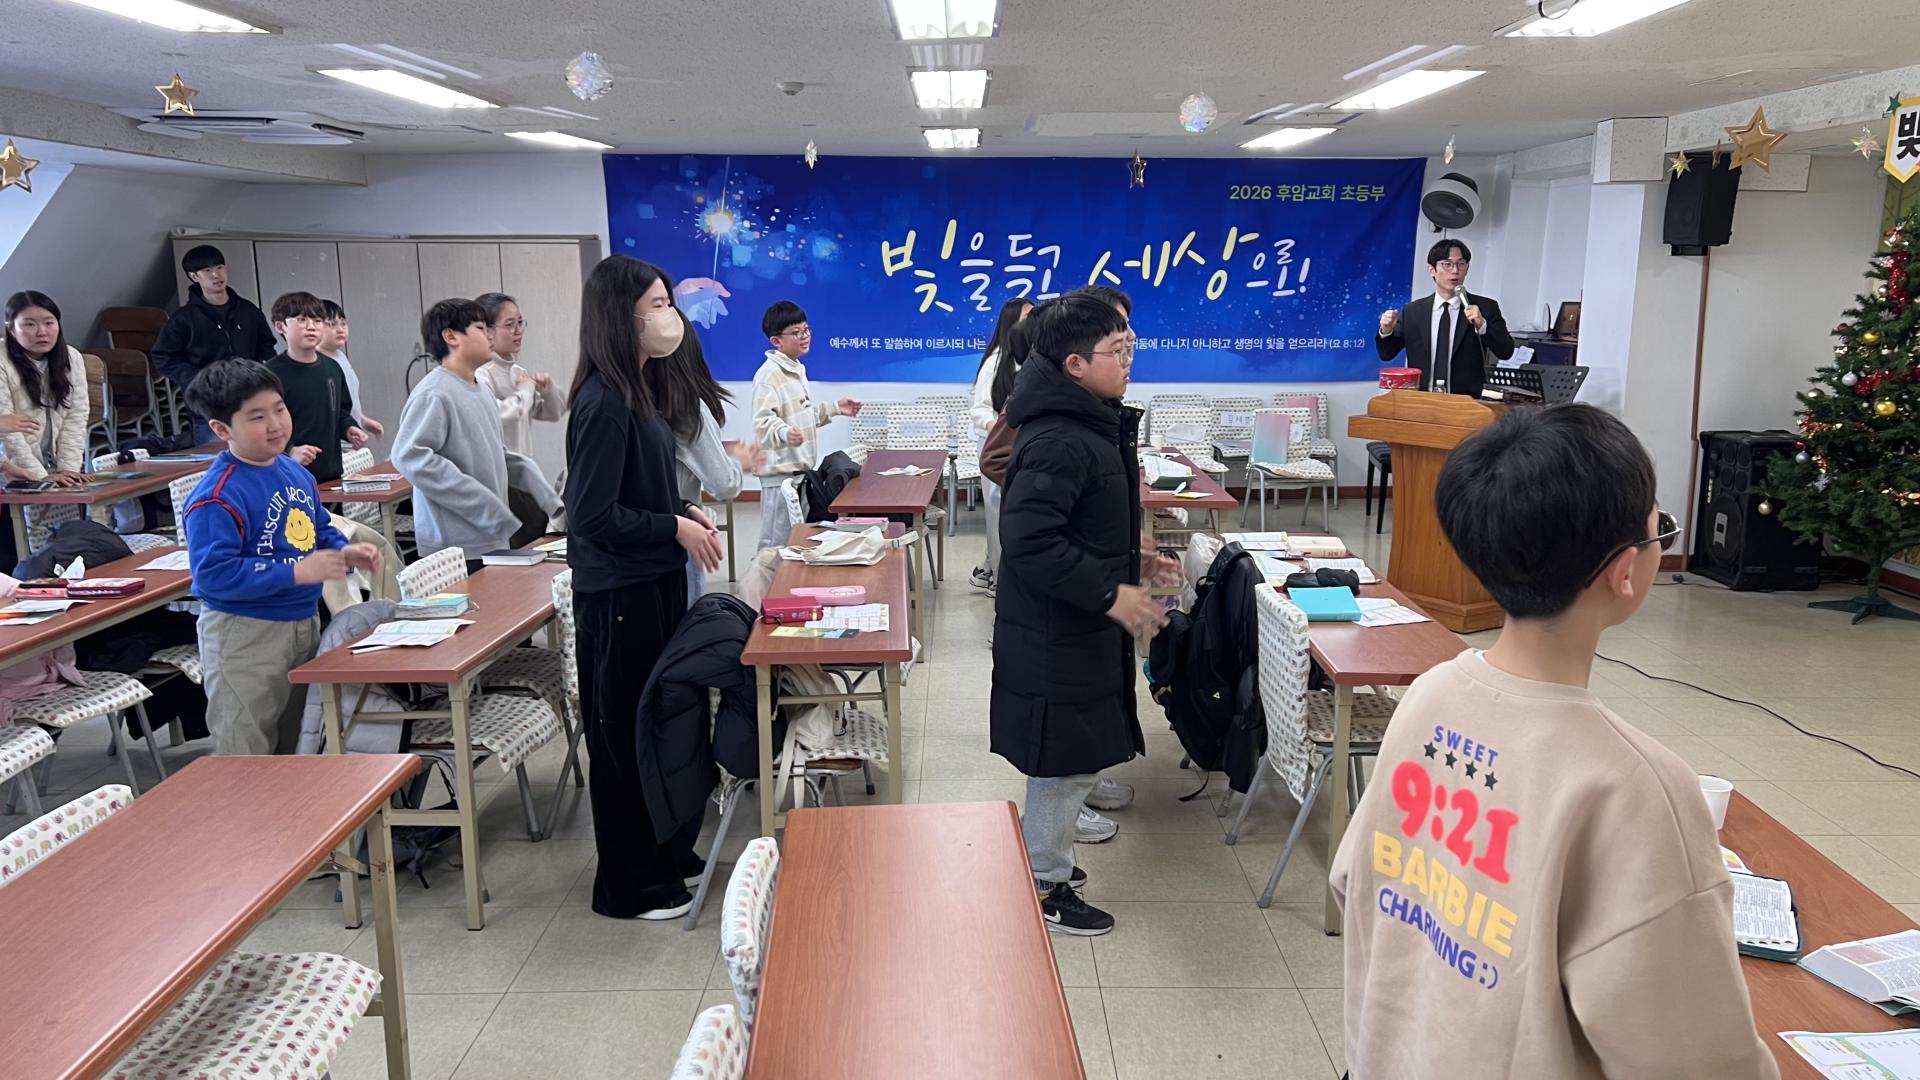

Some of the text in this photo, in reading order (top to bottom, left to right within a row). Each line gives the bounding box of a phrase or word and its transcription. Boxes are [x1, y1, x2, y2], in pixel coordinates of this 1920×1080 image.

[1229, 184, 1386, 202] 2026 후암교회 초등부
[881, 219, 994, 313] 빛을
[1088, 226, 1311, 300] 세상으로!
[829, 337, 869, 350] 예수께서
[871, 338, 882, 349] 또
[884, 337, 923, 350] 말씀하여
[925, 337, 964, 350] 이르시되
[967, 338, 988, 350] 나는
[1160, 338, 1190, 350] 다니지
[1192, 338, 1231, 350] 아니하고
[1234, 338, 1263, 350] 생명의
[1266, 337, 1285, 350] 빛을
[1288, 338, 1328, 350] 얻으리라
[1433, 725, 1499, 768] SWEET
[1391, 760, 1520, 885] 9:21
[1373, 831, 1519, 960] BARBIE
